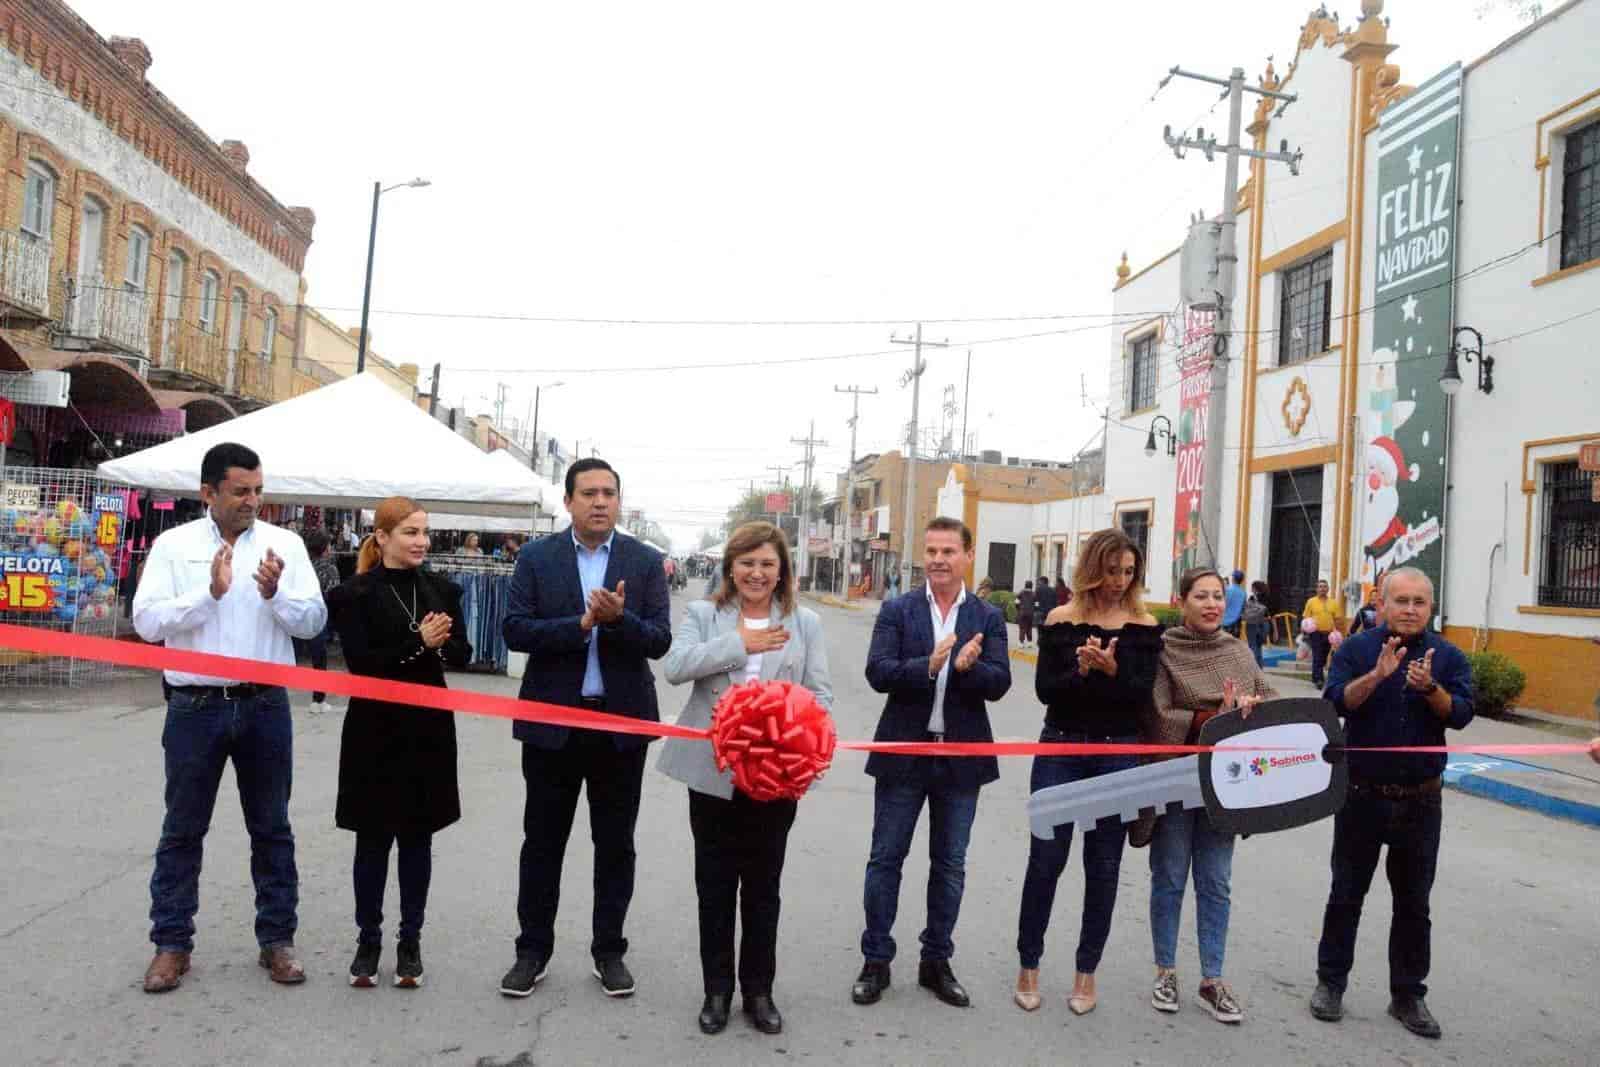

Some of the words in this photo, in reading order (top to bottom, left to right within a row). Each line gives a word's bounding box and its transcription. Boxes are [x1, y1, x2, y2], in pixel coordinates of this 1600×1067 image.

[1178, 446, 1202, 493] 202
[95, 495, 123, 512] PELOTA
[1269, 752, 1316, 767] Sabinas
